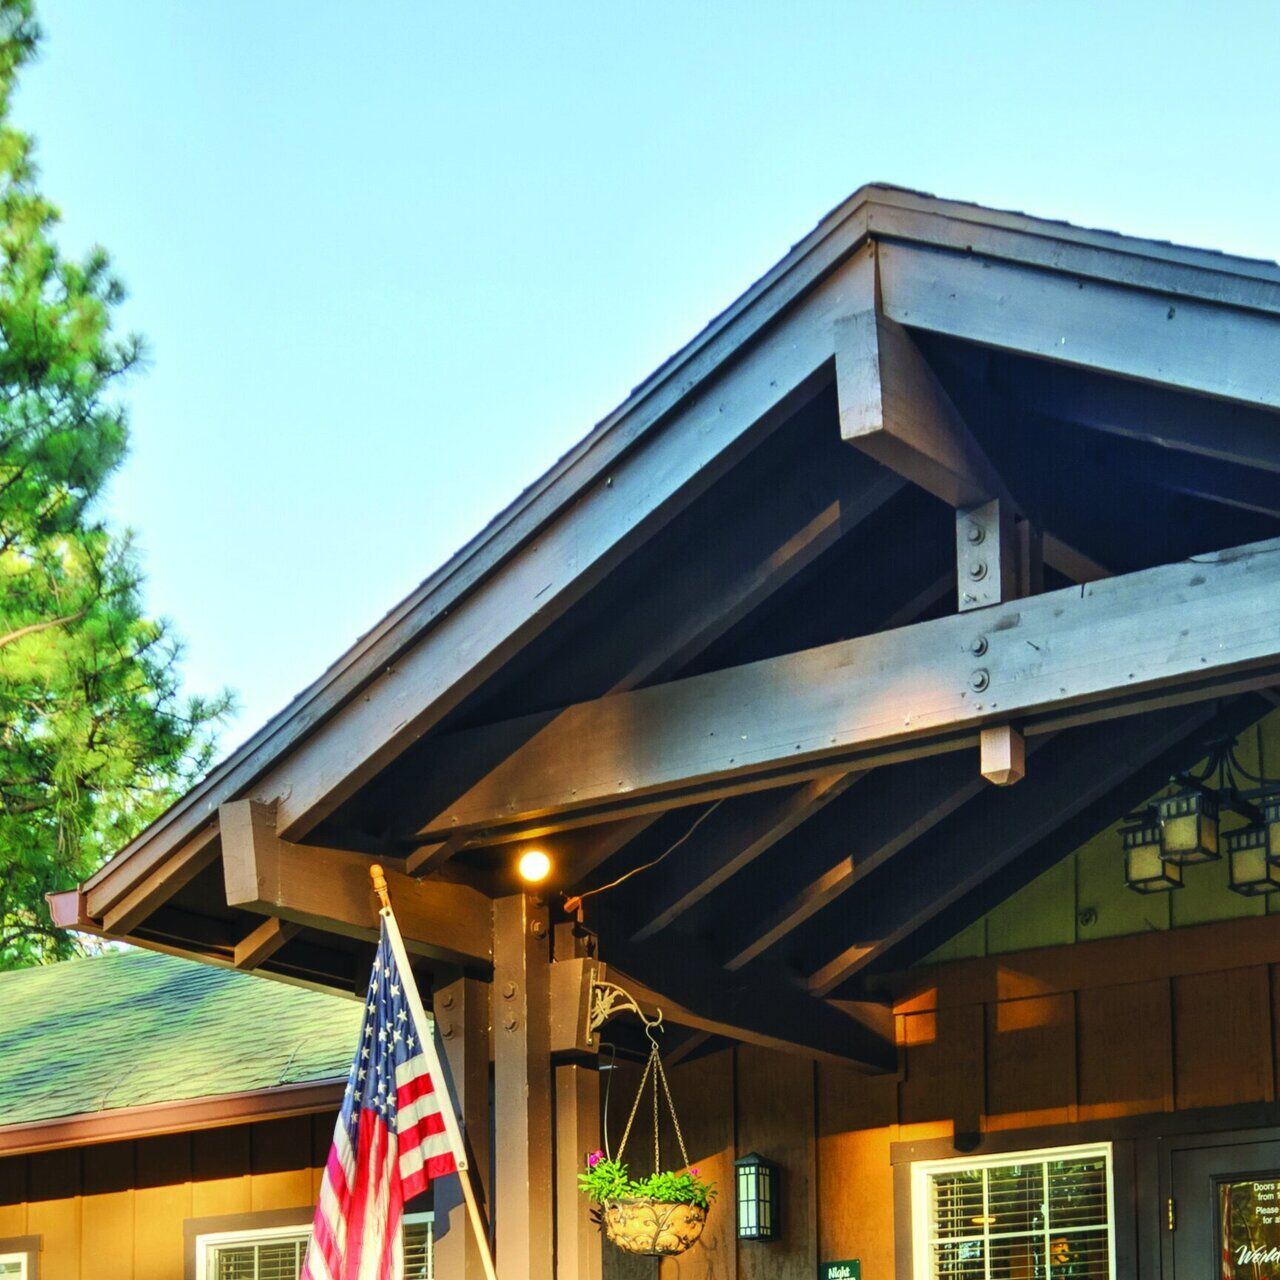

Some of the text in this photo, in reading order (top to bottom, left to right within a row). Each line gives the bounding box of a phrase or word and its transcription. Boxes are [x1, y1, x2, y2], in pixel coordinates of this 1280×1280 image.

[1254, 1182, 1275, 1191] Doors
[1258, 1192, 1274, 1200] from
[1256, 1206, 1279, 1215] Please
[1263, 1216, 1272, 1224] for
[828, 1266, 850, 1279] Night
